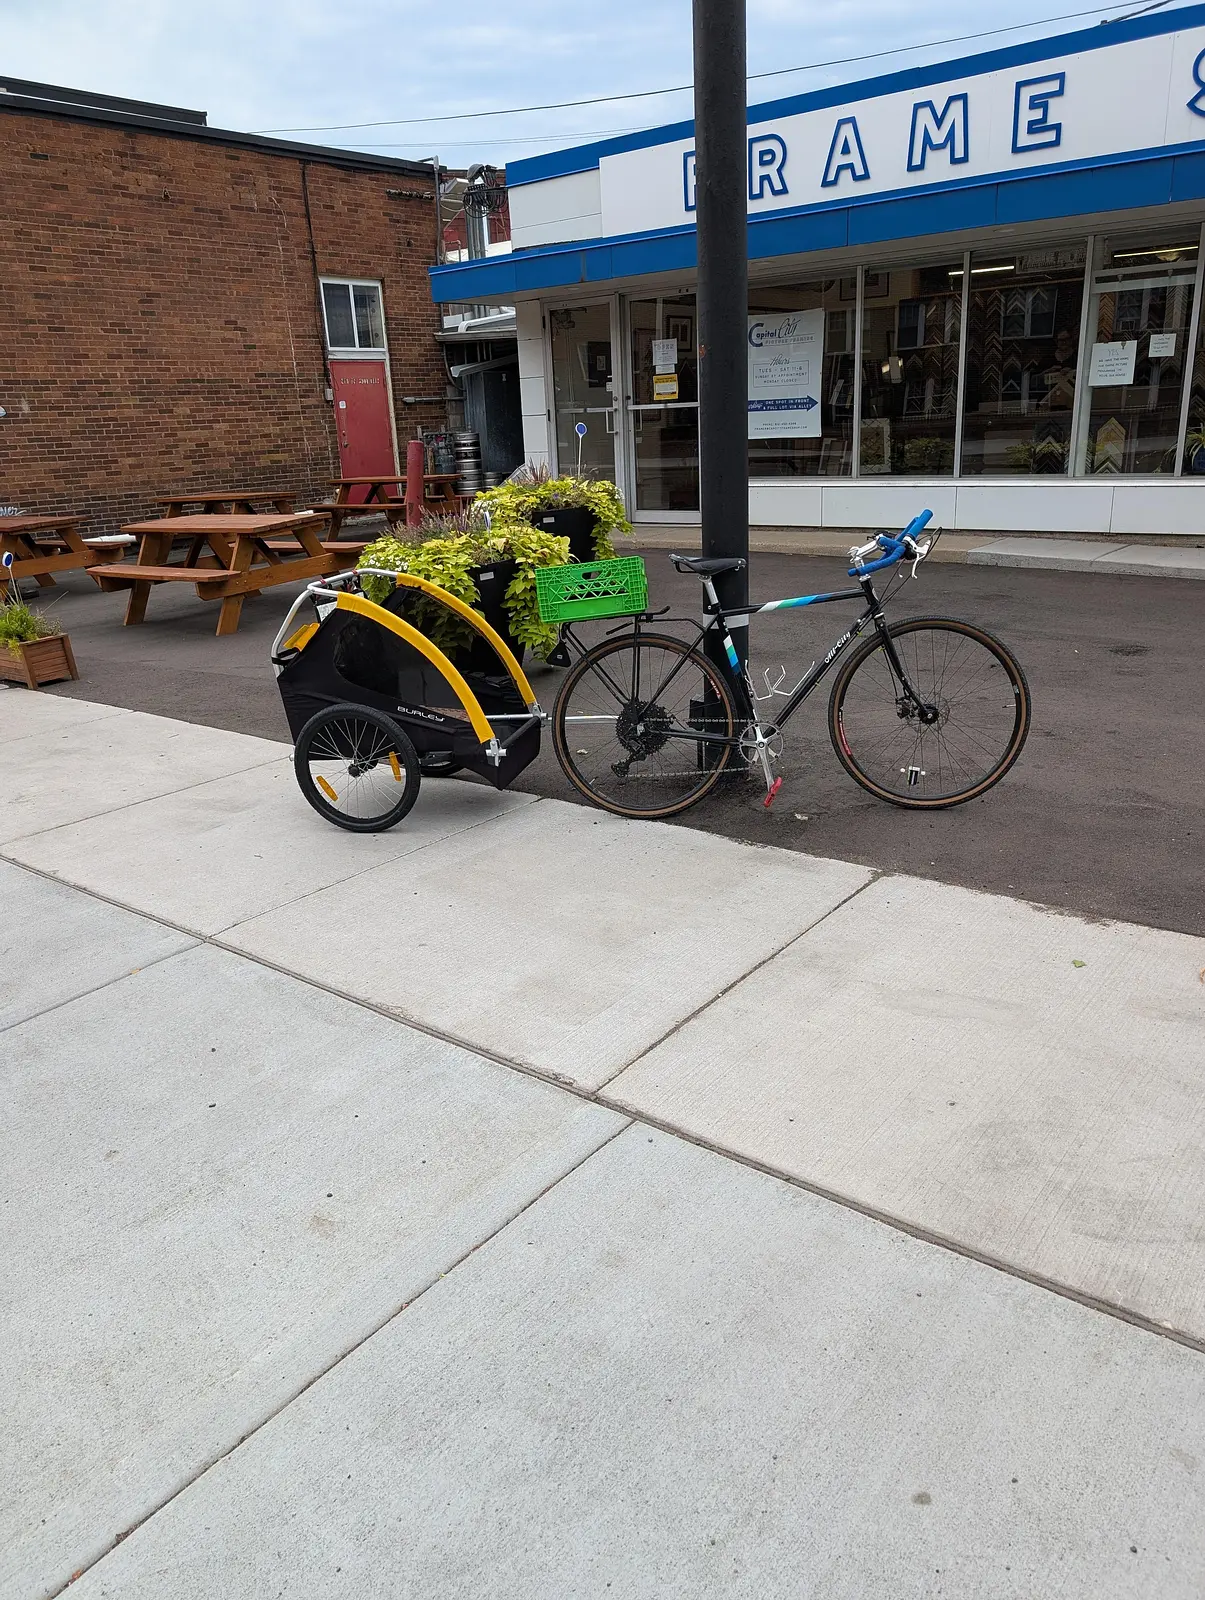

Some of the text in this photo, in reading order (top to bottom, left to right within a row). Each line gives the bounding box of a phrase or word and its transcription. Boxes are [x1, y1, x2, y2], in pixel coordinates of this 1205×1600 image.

[748, 317, 801, 347] Capital City
[770, 353, 790, 366] Hours
[824, 631, 851, 663] All-City
[397, 705, 446, 722] BURLEY
